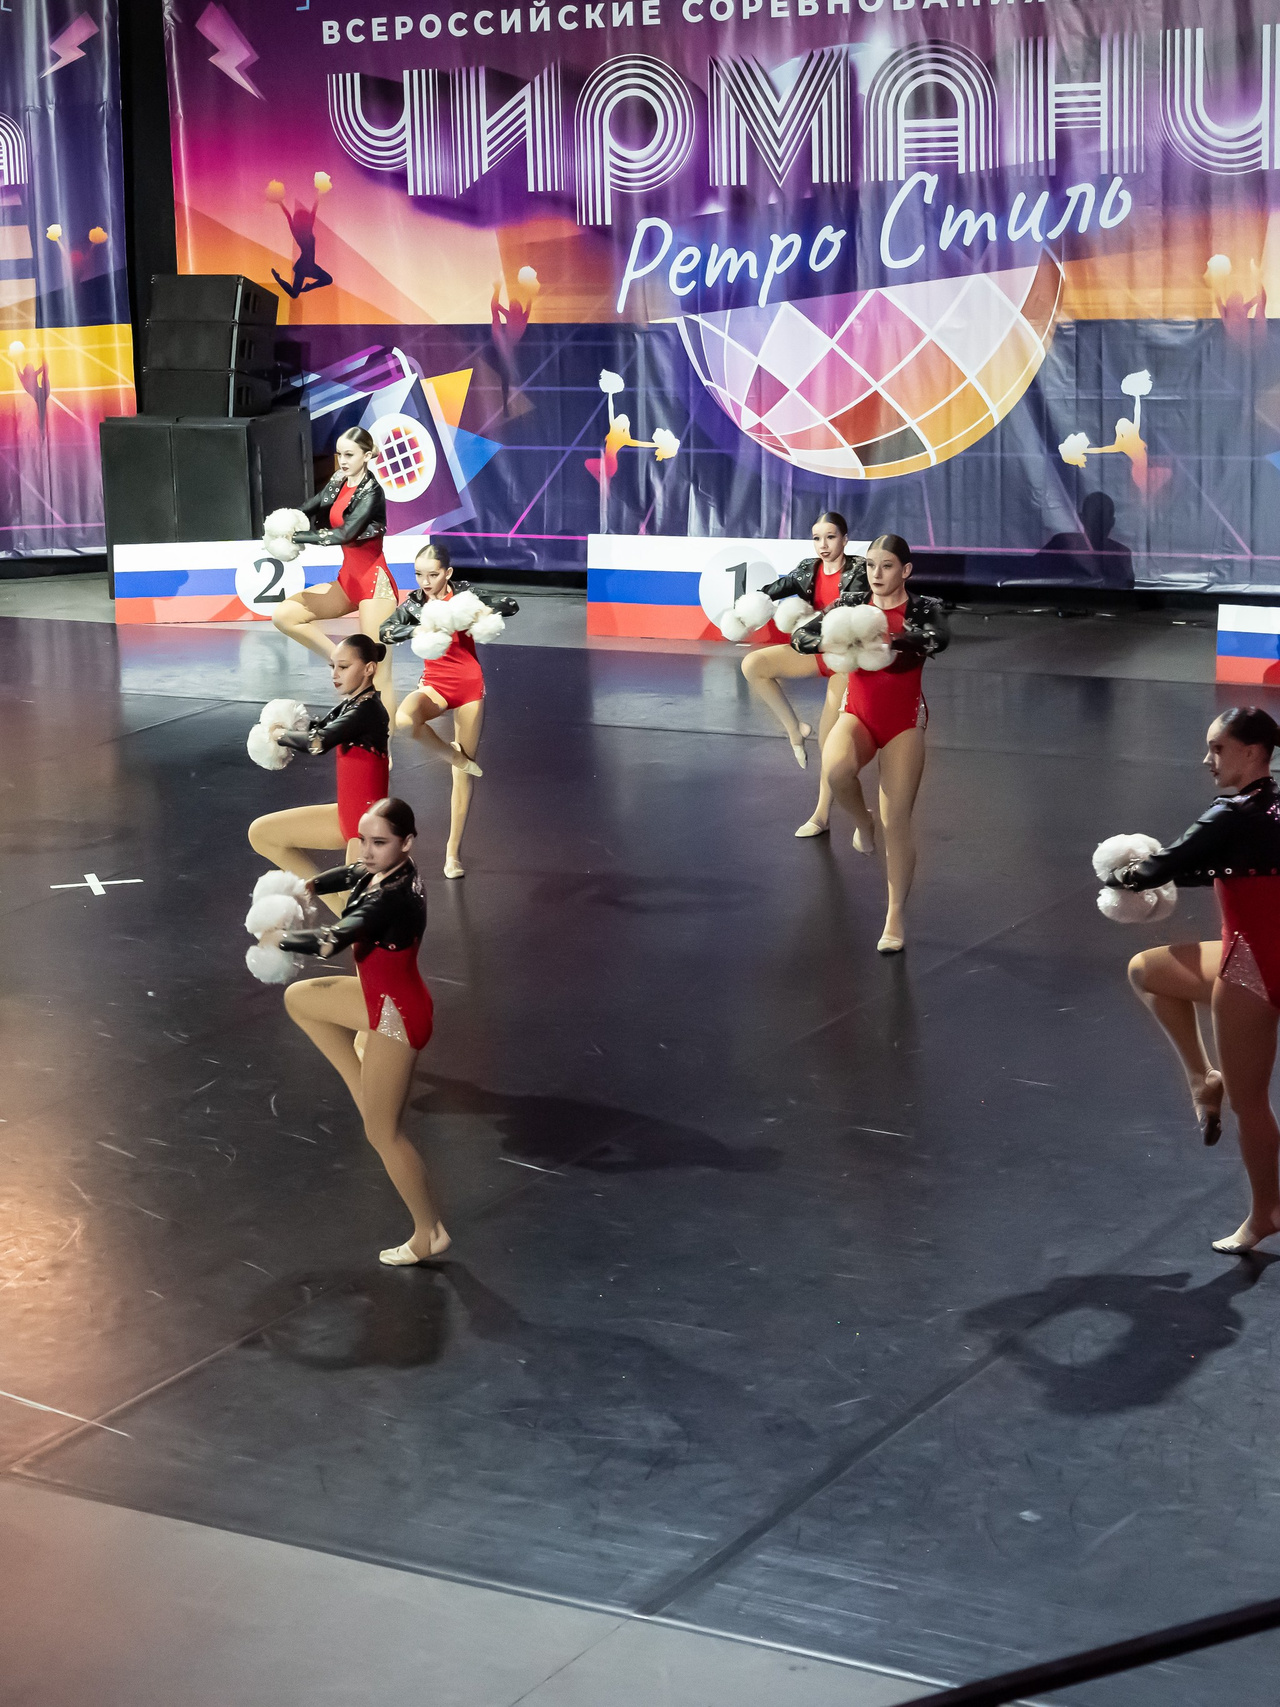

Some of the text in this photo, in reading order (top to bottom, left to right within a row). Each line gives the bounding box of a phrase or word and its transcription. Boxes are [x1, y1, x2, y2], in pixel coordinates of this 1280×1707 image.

[322, 0, 661, 44] ВСЕРОССИЙСКИЕ
[616, 171, 1132, 313] Ретро Стиль
[253, 557, 286, 604] 2
[725, 561, 748, 610] 1
